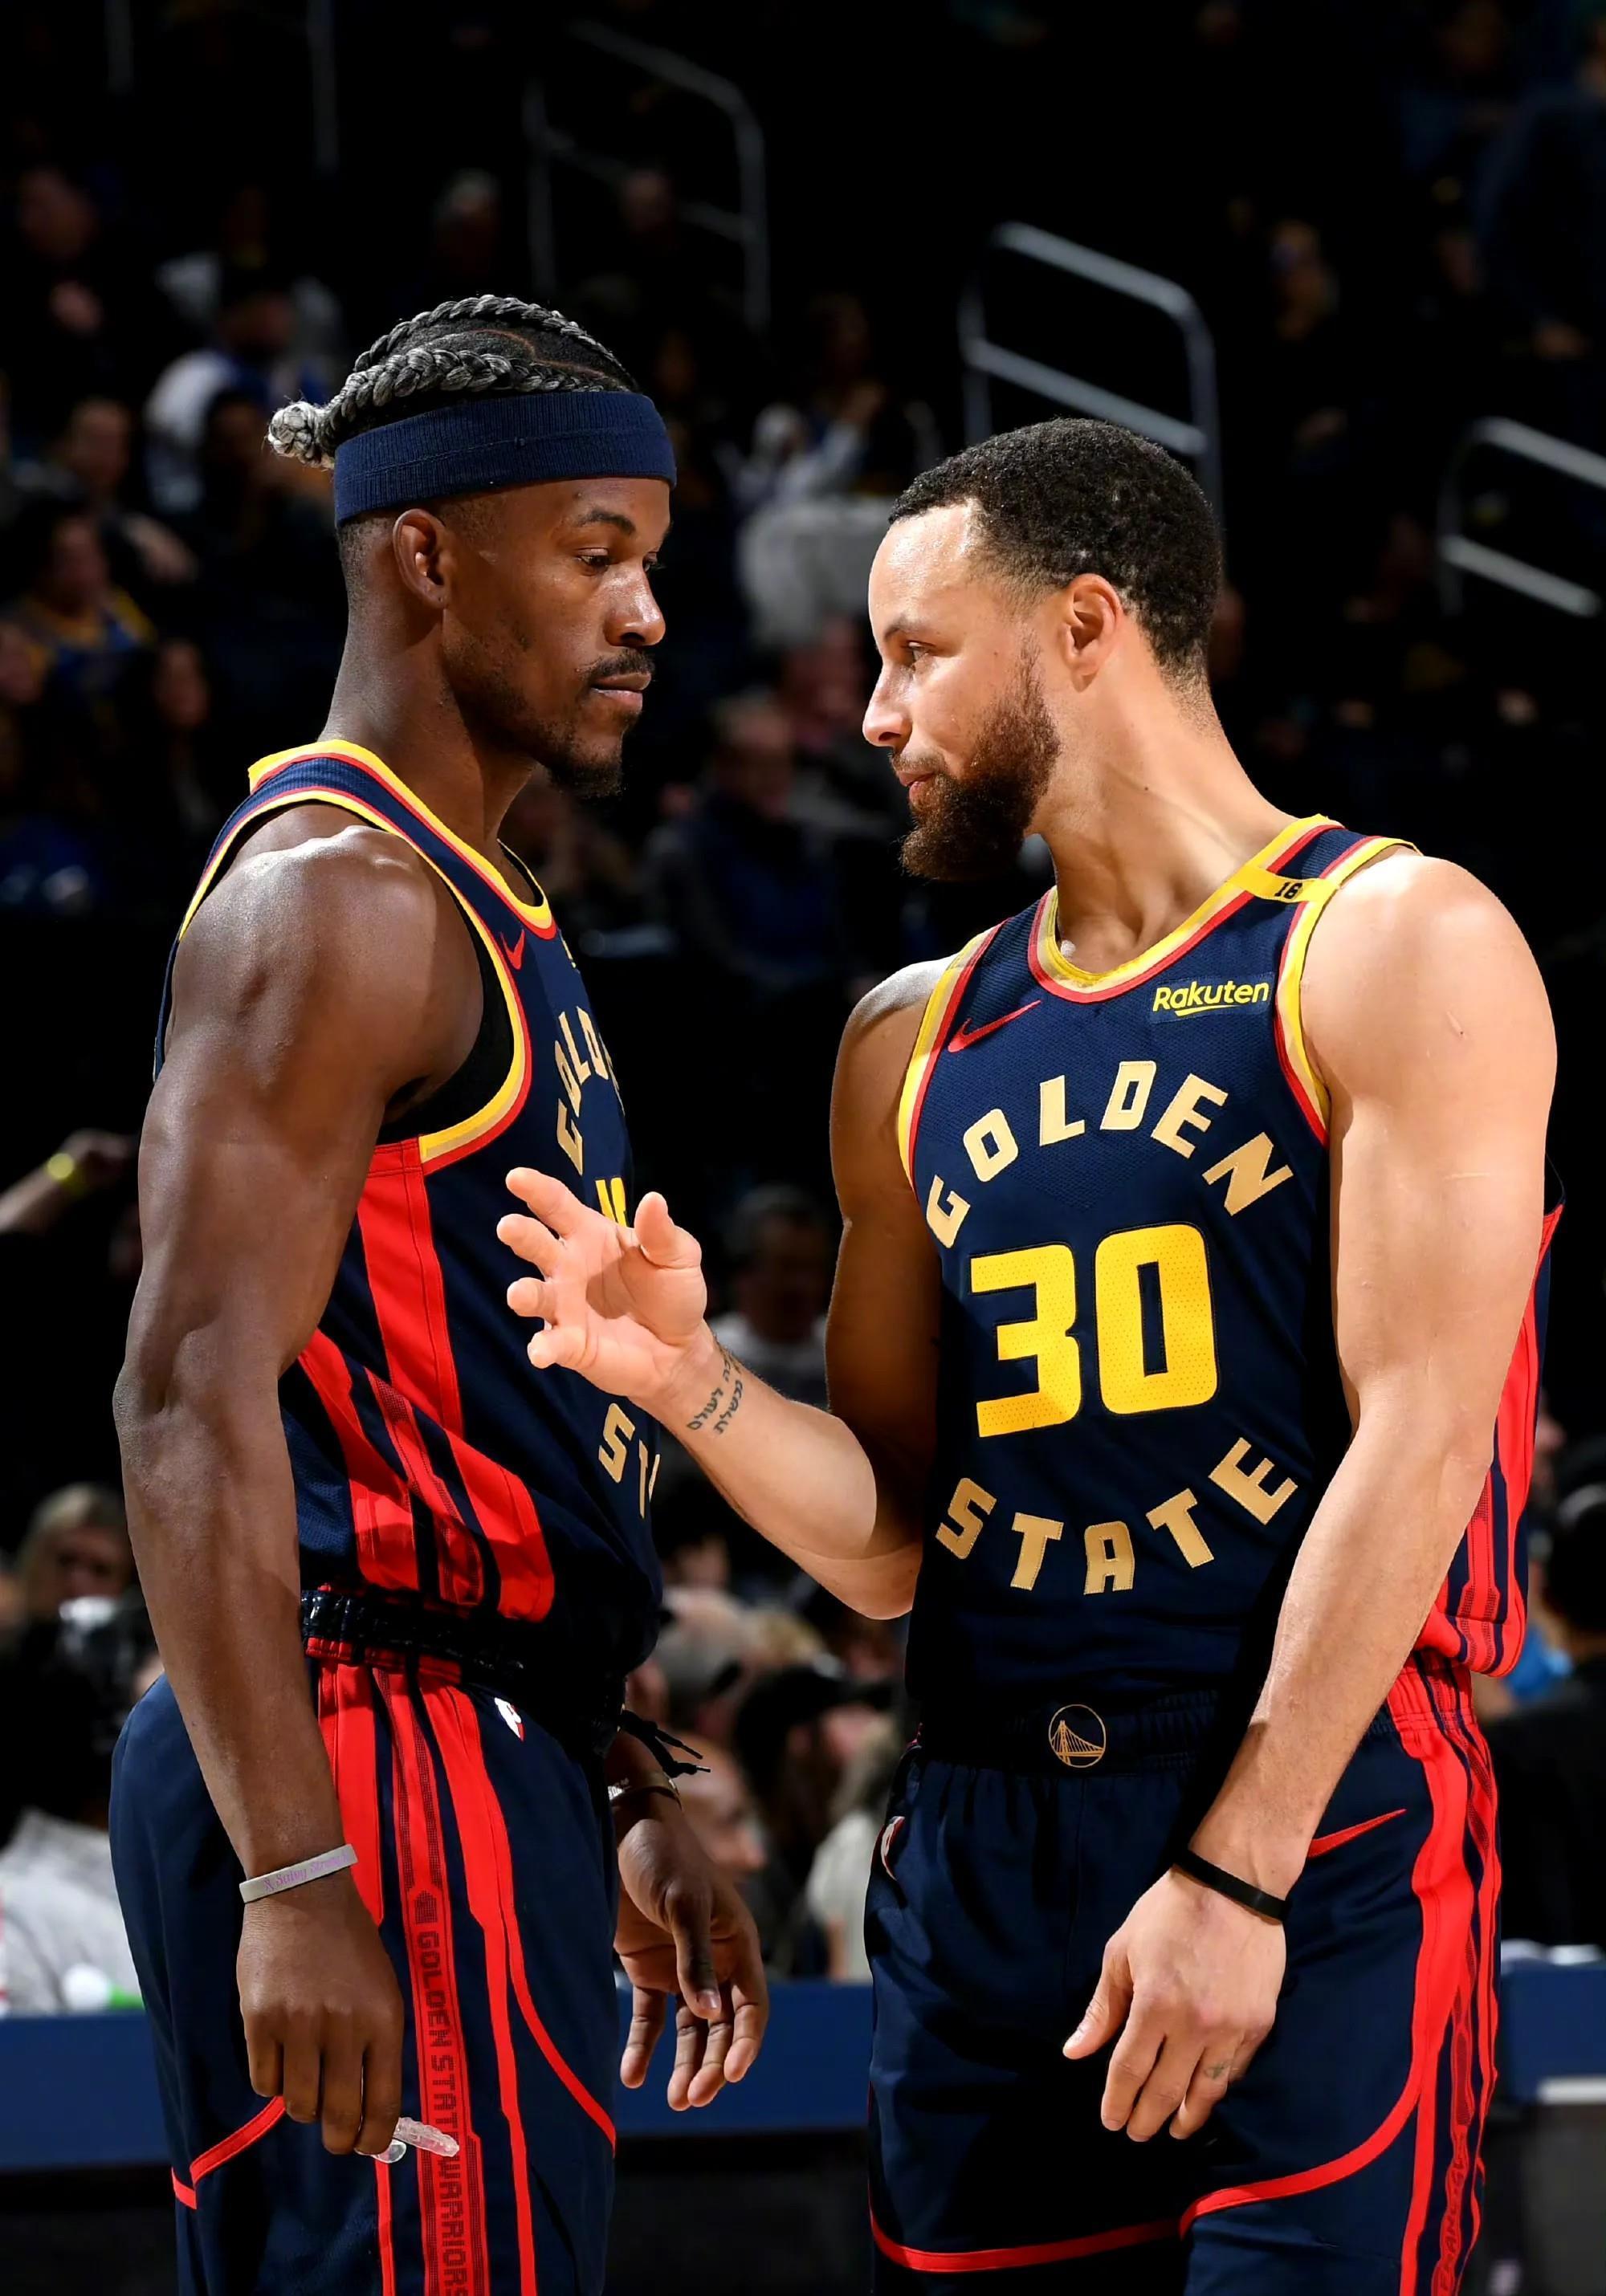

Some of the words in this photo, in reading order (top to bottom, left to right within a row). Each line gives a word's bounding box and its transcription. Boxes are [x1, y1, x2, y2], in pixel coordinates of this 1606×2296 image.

[1274, 881, 1303, 900] 16
[1152, 980, 1270, 1013] Rakuten
[554, 1005, 626, 1176] GOLD
[926, 1060, 1294, 1248] GOLDEN
[970, 1223, 1218, 1438] 30
[934, 1437, 1298, 1595] STATE
[417, 1930, 452, 2047] GOLDEN
